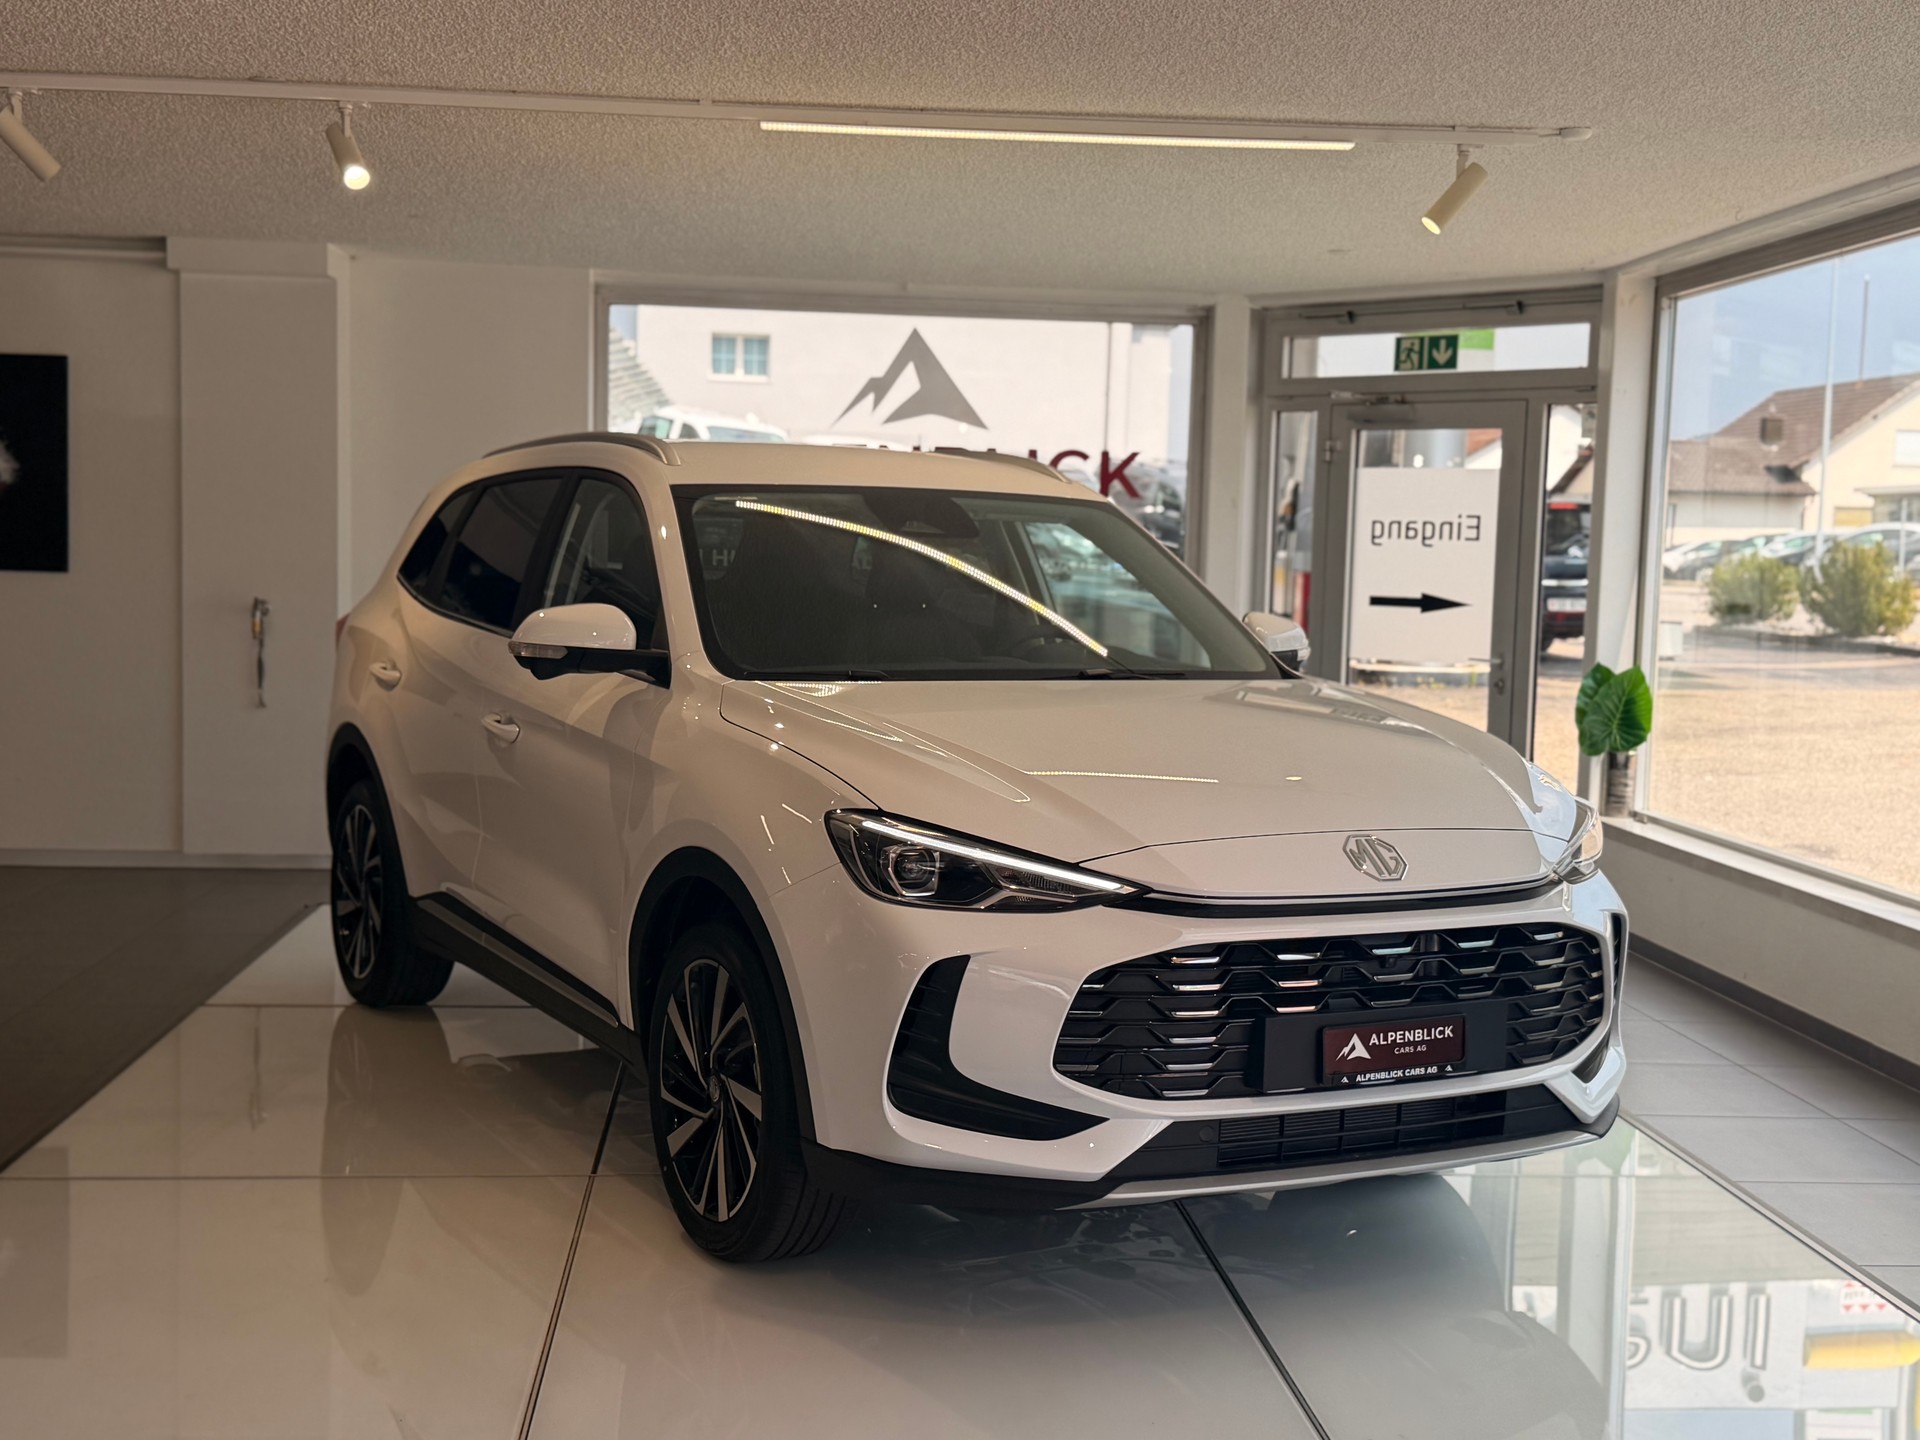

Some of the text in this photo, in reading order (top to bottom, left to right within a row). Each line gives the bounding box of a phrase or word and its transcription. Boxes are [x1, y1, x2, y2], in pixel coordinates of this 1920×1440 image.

[1347, 836, 1405, 879] MG
[1369, 1025, 1453, 1046] ALPENBLICK
[1394, 1044, 1427, 1055] CARS AG
[1356, 1065, 1438, 1082] ALPENBLICK CARS AG
